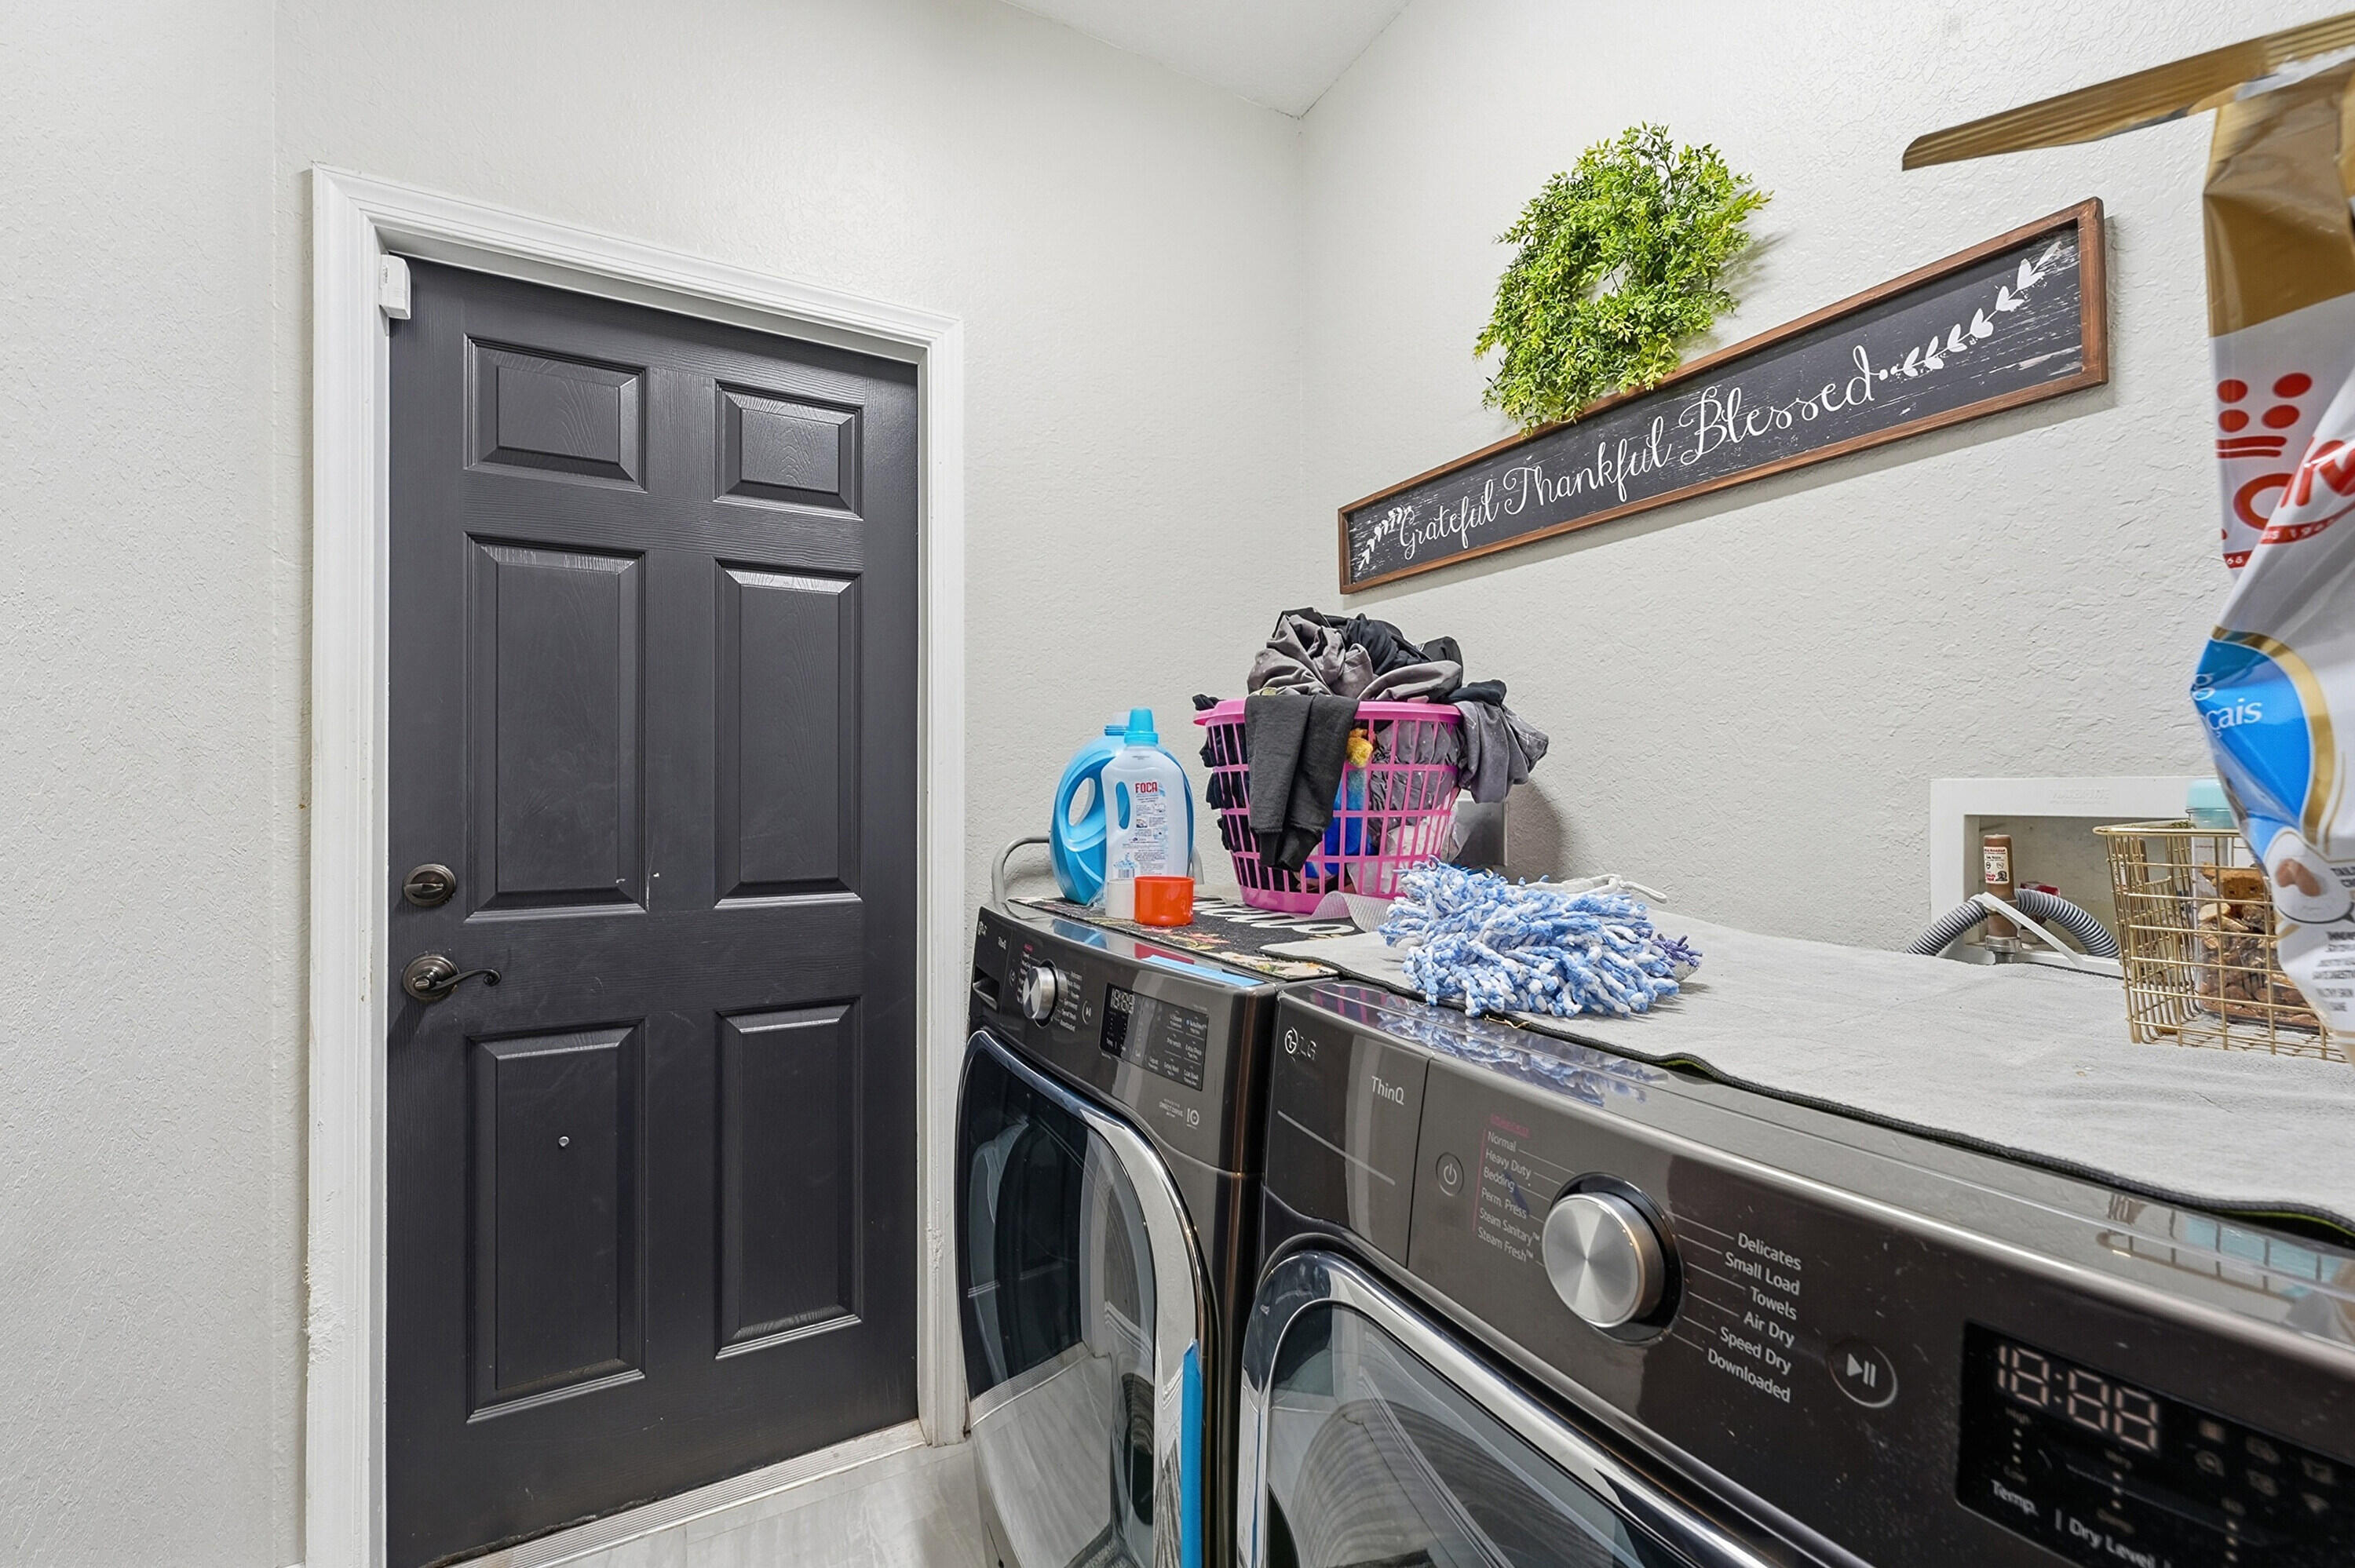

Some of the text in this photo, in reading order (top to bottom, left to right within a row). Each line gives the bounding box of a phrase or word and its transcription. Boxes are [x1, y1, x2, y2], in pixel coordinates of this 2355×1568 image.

[1400, 345, 1876, 552] Grateful Thankful Blessed
[1134, 782, 1158, 793] FOCA
[1371, 1076, 1404, 1105] ThinQ
[1488, 1131, 1517, 1152] Normal
[1483, 1166, 1515, 1194] Bedding
[1485, 1148, 1532, 1180] Heavy Duty
[1479, 1207, 1502, 1228] Steam
[1481, 1187, 1527, 1220] Perm. Press
[1477, 1227, 1502, 1249] Steam
[1737, 1231, 1802, 1271] Delicates
[1725, 1251, 1801, 1296] Small Load
[1750, 1285, 1798, 1321] Towels
[1743, 1311, 1795, 1349] Air Dry
[1719, 1326, 1792, 1376] Speed Dry
[1707, 1347, 1791, 1404] Downloaded
[1998, 1344, 2159, 1452] 18:88
[2068, 1516, 2104, 1549] Dry
[2105, 1533, 2156, 1568] Level
